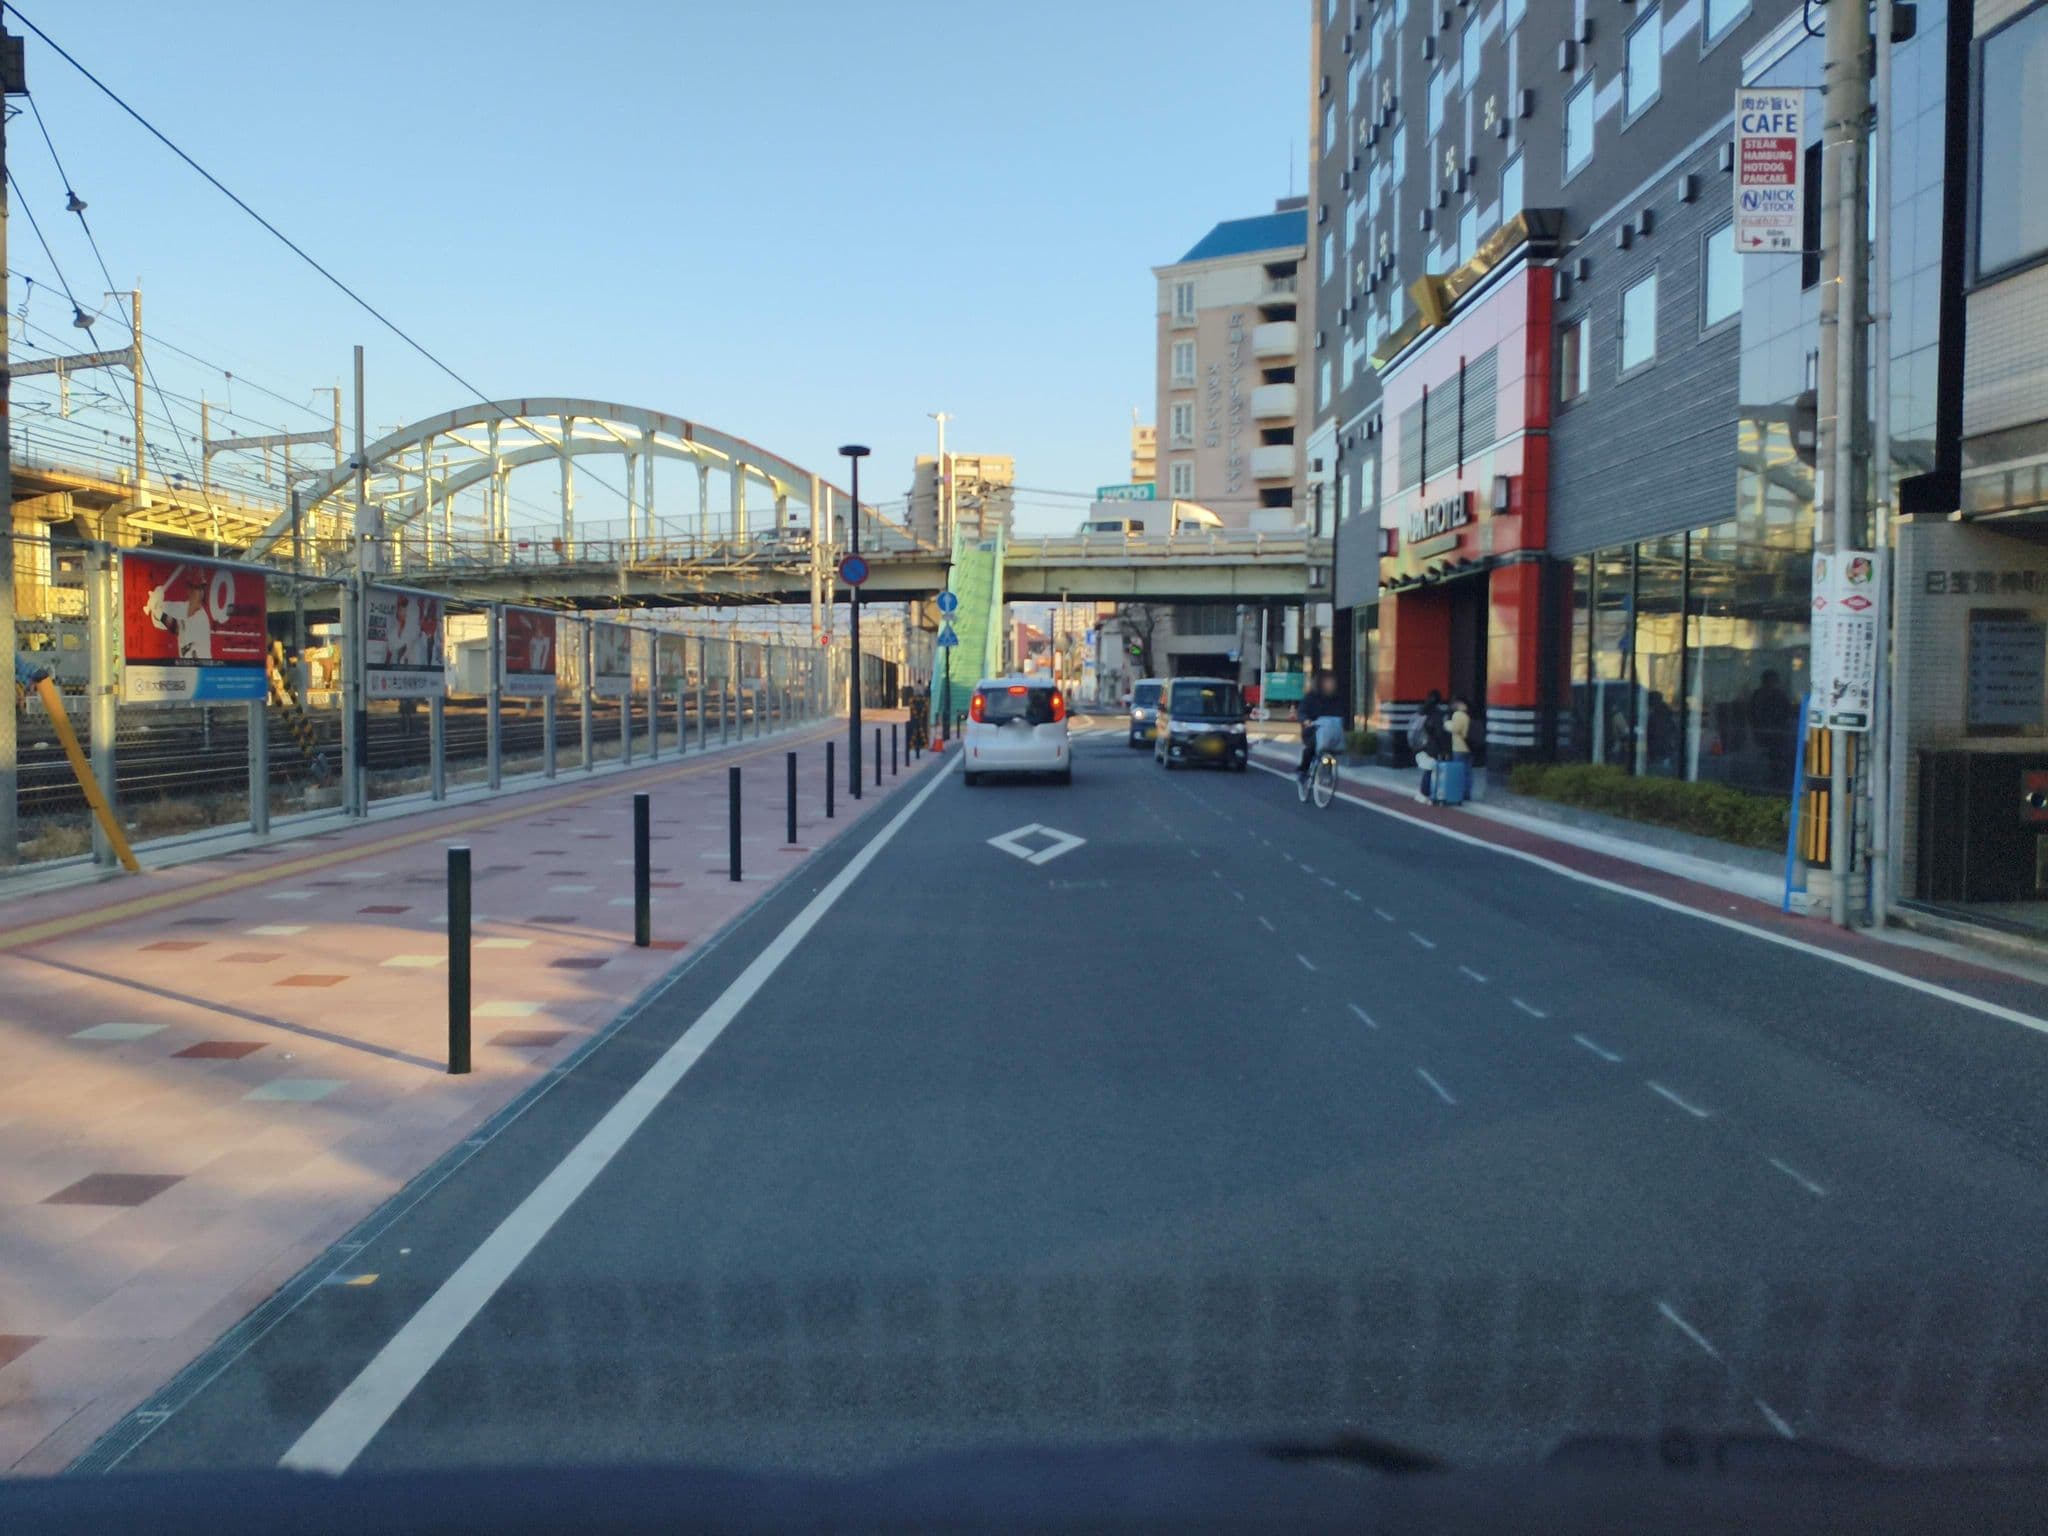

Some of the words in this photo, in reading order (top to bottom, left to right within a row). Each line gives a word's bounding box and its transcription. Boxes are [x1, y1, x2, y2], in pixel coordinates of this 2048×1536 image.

[1742, 96, 1798, 111] 肉が旨い
[1742, 114, 1797, 133] CAFE
[1745, 139, 1776, 148] STEAK
[1743, 151, 1793, 160] HAMBURG
[1743, 162, 1784, 172] HOTDOG
[1743, 174, 1788, 184] PANCAKE
[1762, 190, 1795, 201] NICK
[1763, 202, 1795, 212] STOCK
[1427, 495, 1467, 536] HOTEL
